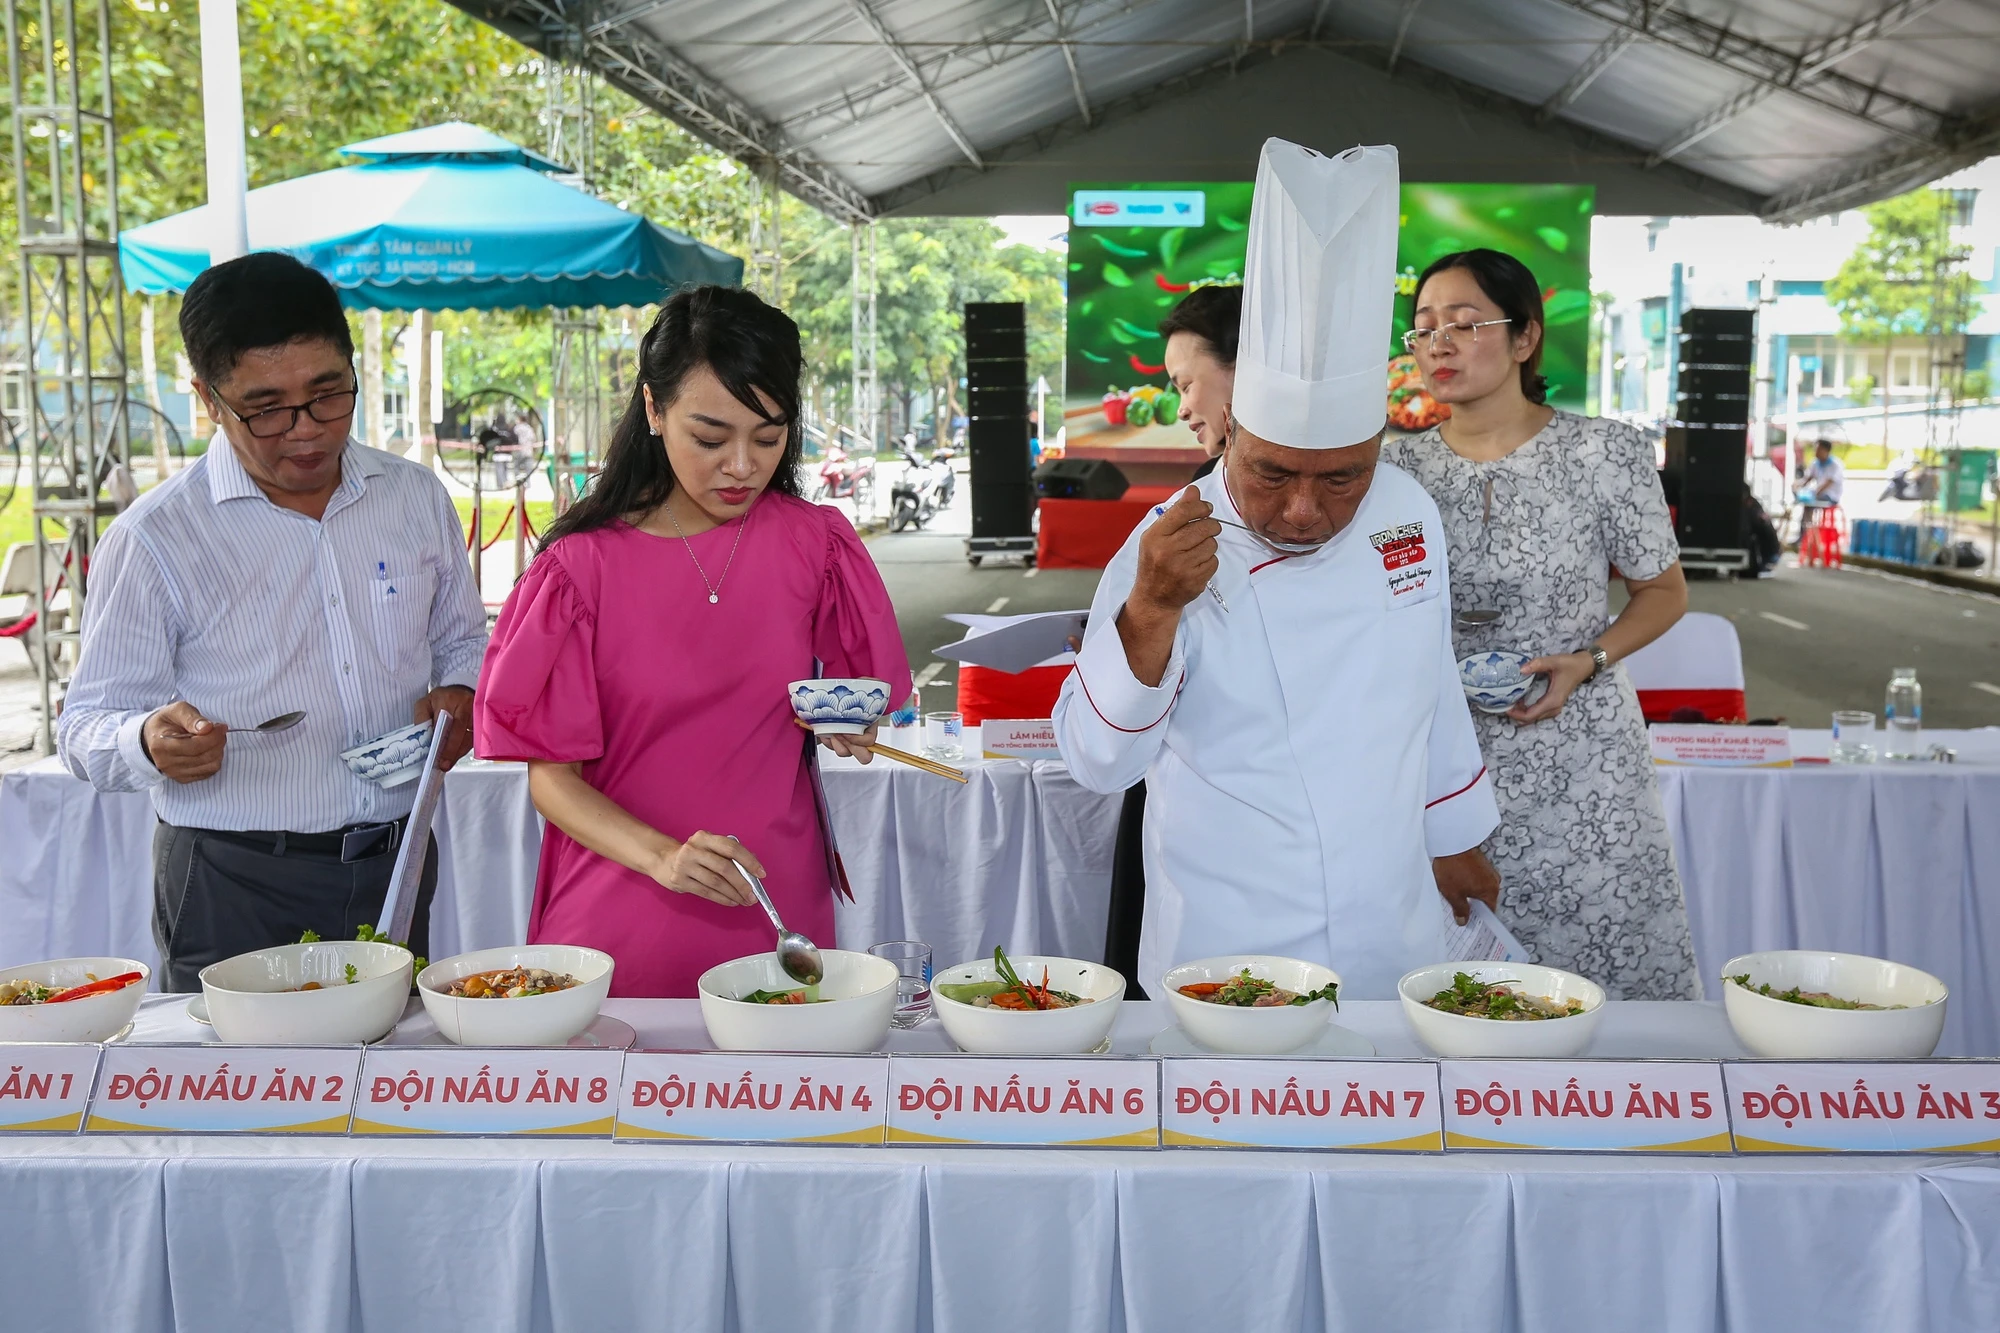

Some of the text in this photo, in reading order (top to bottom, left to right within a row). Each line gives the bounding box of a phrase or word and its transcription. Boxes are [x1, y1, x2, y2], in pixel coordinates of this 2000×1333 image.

[1369, 521, 1424, 546] IRON CHEF
[1010, 731, 1030, 740] LÂM
[0, 1066, 73, 1099] ĂN 1
[109, 1063, 343, 1109] ĐỘI NẤU ĂN 2
[371, 1064, 608, 1112] ĐỘI NẤU ĂN 8
[632, 1070, 872, 1116] ĐỘI NẤU ĂN 4
[898, 1074, 1144, 1121] ĐỘI NẤU ĂN 6
[1175, 1076, 1425, 1123] ĐỘI NẤU ĂN 7
[1455, 1076, 1712, 1125] ĐỘI NẤU ĂN 5
[1743, 1078, 2000, 1128] ĐỘI NẤU ĂN 3
